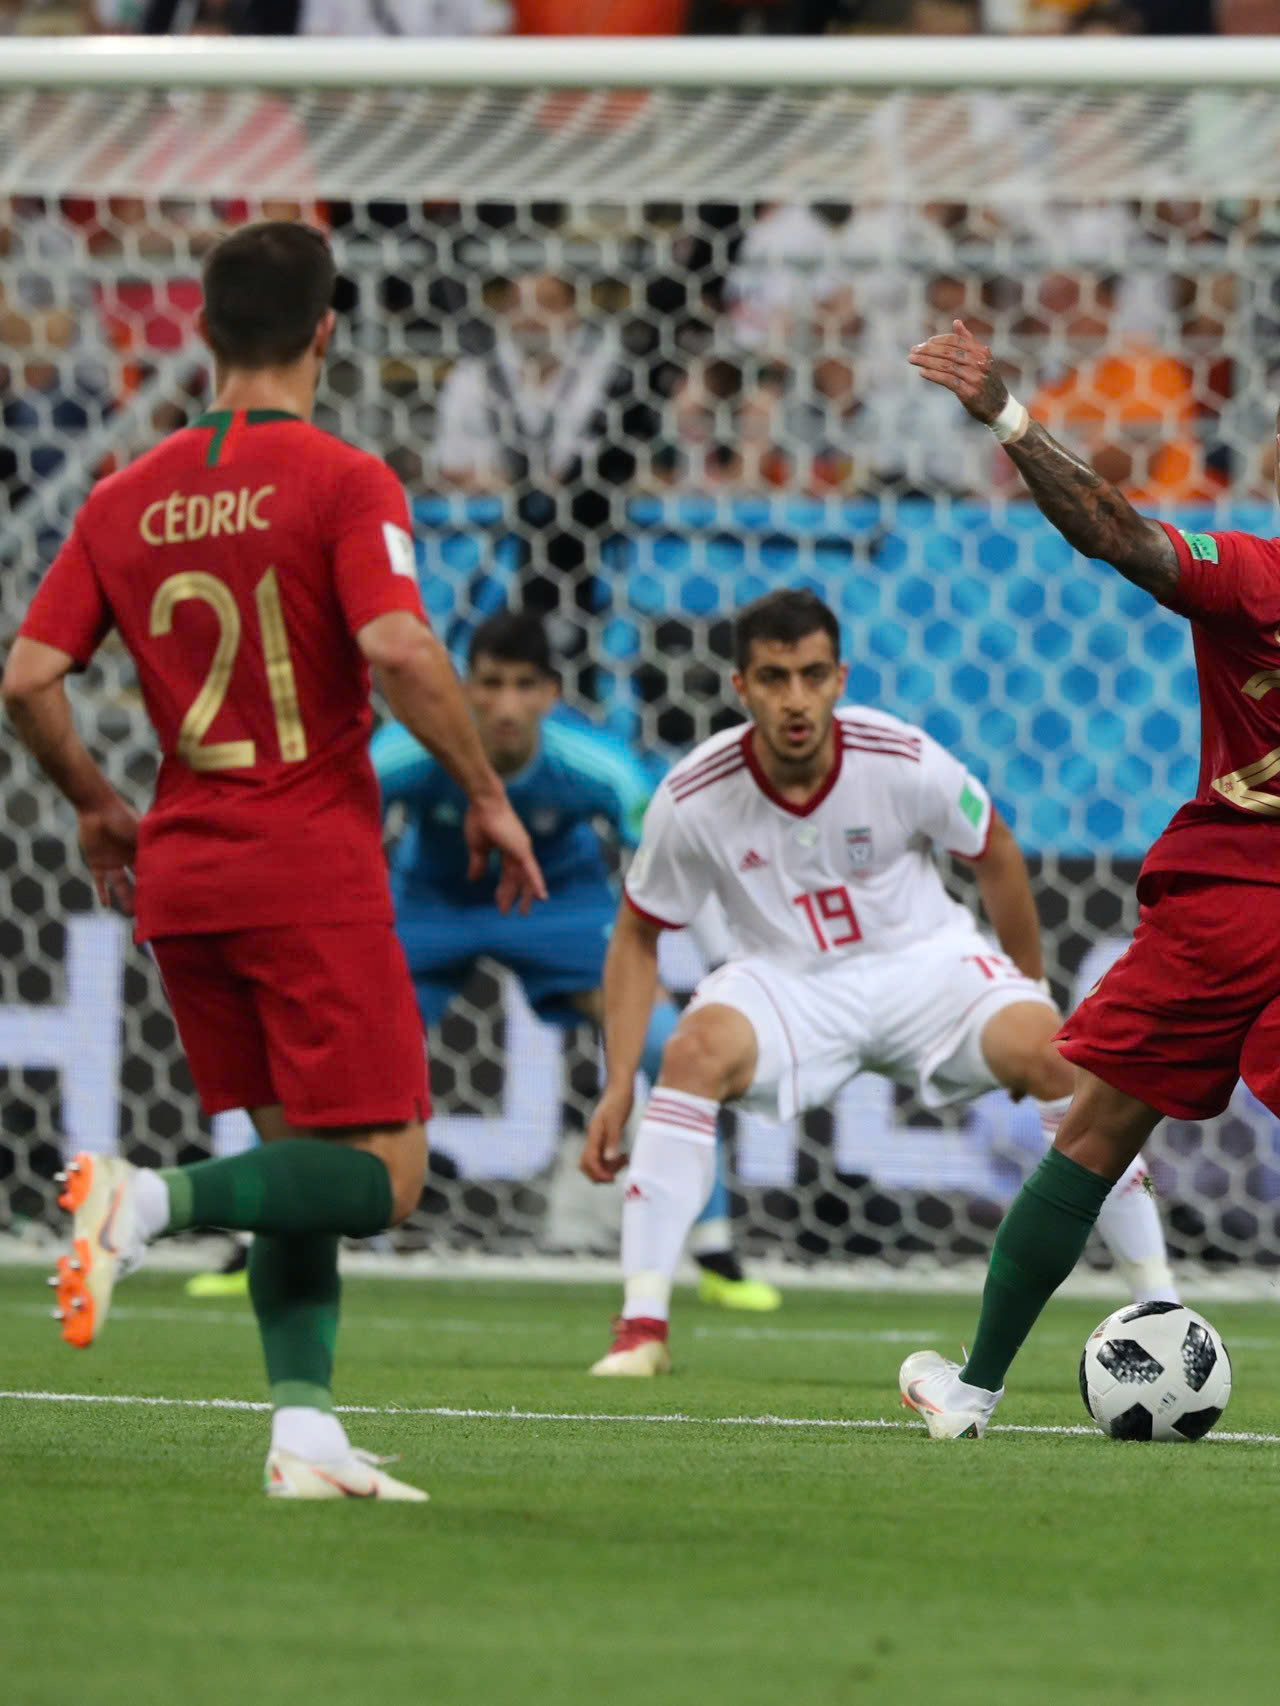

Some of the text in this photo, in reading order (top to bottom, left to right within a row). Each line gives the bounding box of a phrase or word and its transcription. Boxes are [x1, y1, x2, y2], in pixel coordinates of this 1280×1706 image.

[139, 485, 276, 545] CÉDRIC
[150, 565, 307, 772] 21
[792, 886, 863, 953] 19
